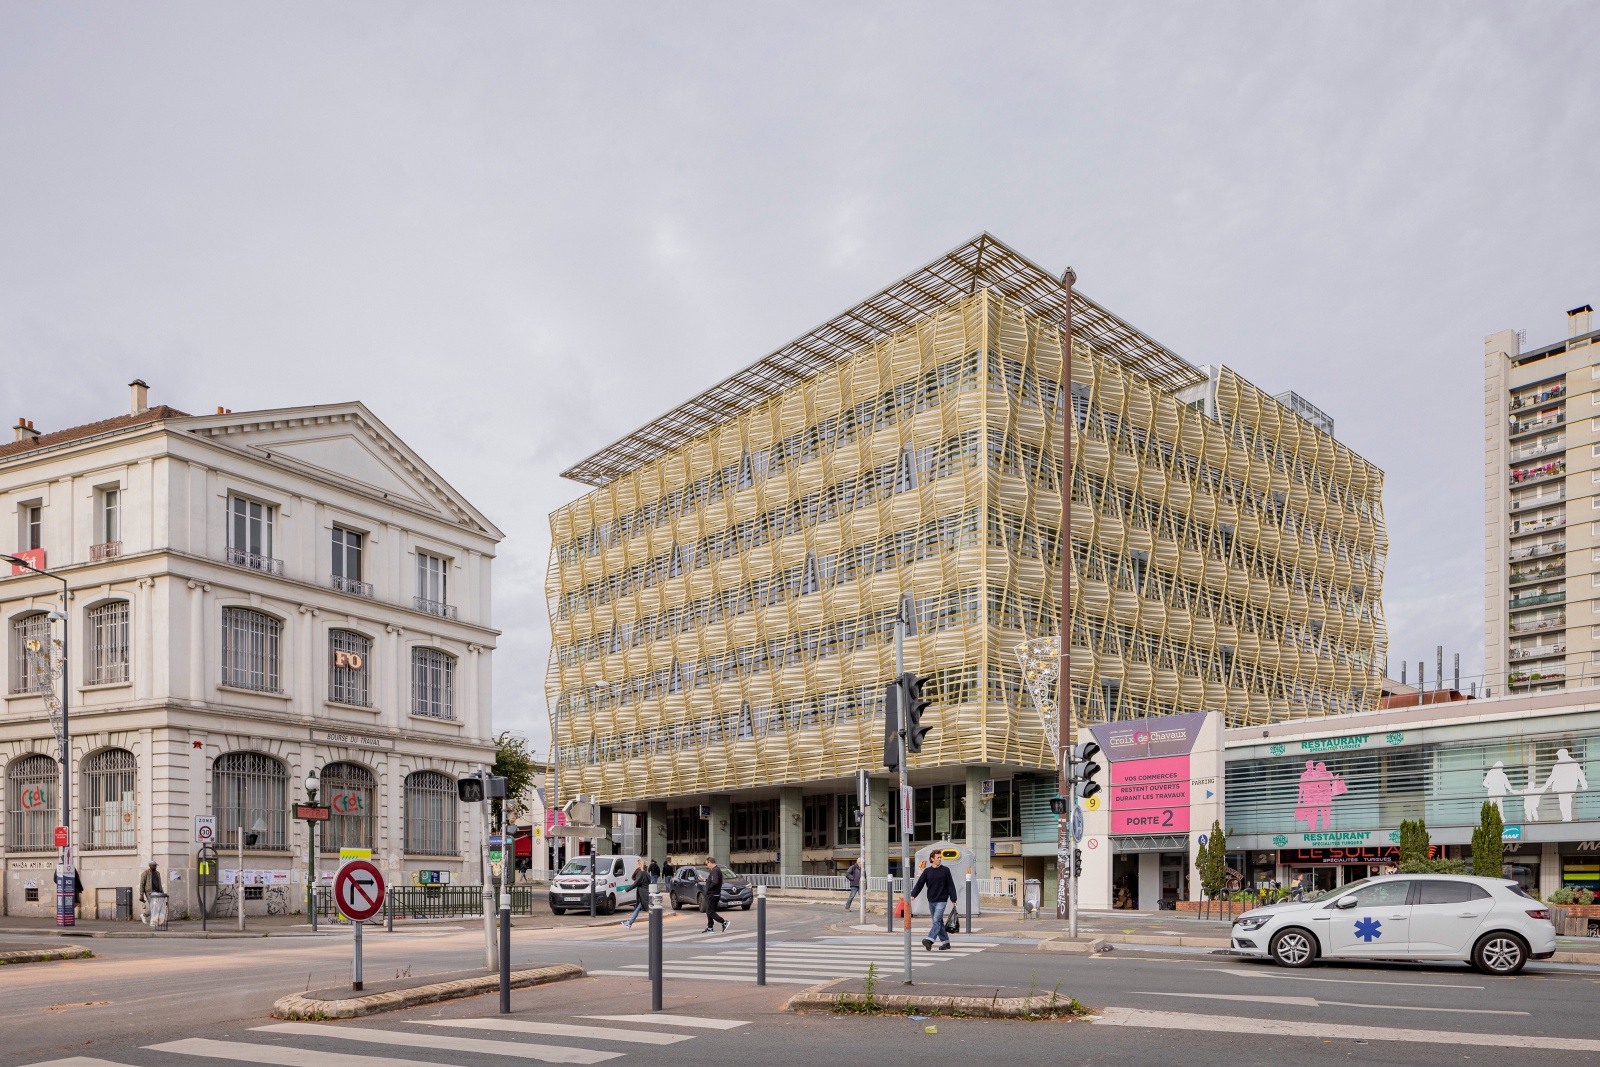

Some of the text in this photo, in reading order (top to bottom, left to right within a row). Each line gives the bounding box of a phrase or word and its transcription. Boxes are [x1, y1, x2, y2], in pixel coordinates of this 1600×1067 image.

[335, 650, 364, 669] FO
[326, 733, 380, 747] BOURSE DU TRAVAIL
[1110, 735, 1134, 746] Croix
[1138, 732, 1149, 743] de
[1150, 731, 1187, 742] Chavaux
[1301, 735, 1370, 749] RESTAURANT
[1138, 772, 1178, 781] COMMERCES
[1149, 783, 1180, 791] OUVERTS
[1191, 778, 1215, 786] PARKING
[1155, 791, 1185, 799] TRAVAUX
[1089, 798, 1096, 808] 9
[1126, 810, 1174, 827] PORTE 2
[1303, 832, 1371, 842] RESTAURANT
[1329, 846, 1401, 858] SULTA
[1502, 843, 1524, 853] AF
[1258, 853, 1267, 864] 2
